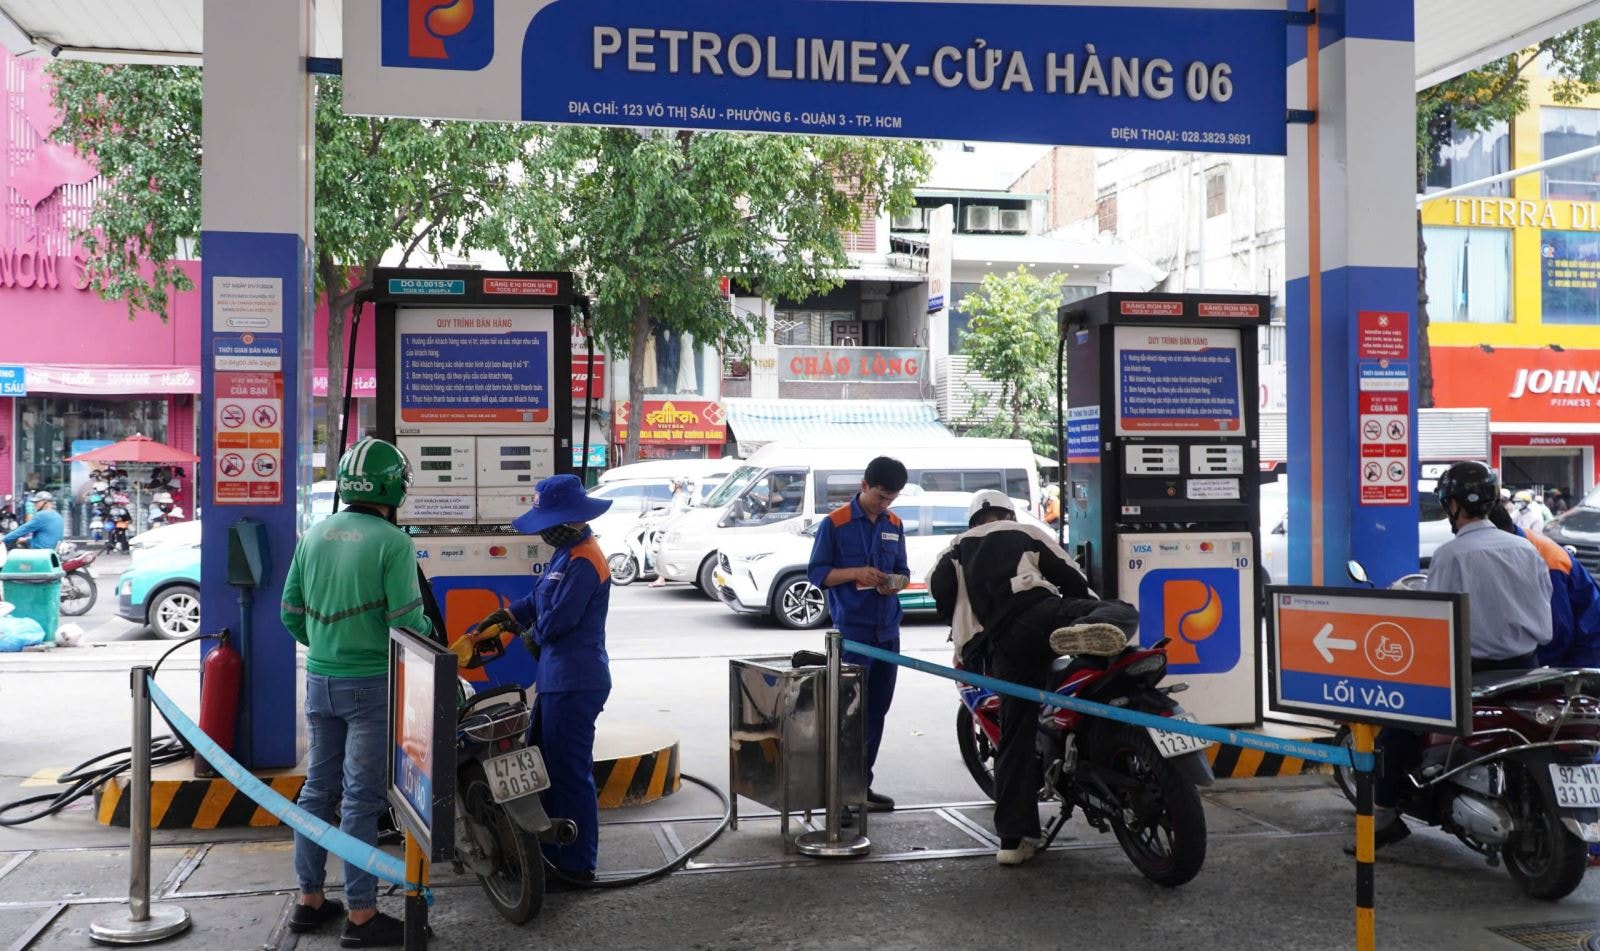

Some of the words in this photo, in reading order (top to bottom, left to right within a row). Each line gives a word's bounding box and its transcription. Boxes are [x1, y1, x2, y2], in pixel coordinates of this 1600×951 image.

[1046, 43, 1174, 100] HÀNG
[1186, 61, 1233, 103] 06
[568, 101, 591, 115] ĐỊA
[593, 100, 619, 115] CHỈ:
[622, 104, 643, 116] 123
[646, 102, 665, 117] VÕ
[667, 106, 688, 121] THỊ
[690, 104, 716, 120] SÁU
[726, 107, 781, 123] PHƯỜNG
[784, 112, 791, 123] 6
[801, 111, 836, 127] QUẬN
[839, 114, 846, 126] 3
[856, 115, 873, 127] TP.
[876, 116, 902, 128] HCM
[1111, 127, 1138, 141] ĐIỆN
[1141, 129, 1179, 143] THOẠI:
[1182, 130, 1251, 145] 028.3829.9691
[1449, 197, 1557, 227] TIERRA
[1571, 203, 1600, 229] DI
[437, 319, 451, 328] QUY
[453, 317, 474, 328] TRÌNH
[790, 352, 851, 375] CHÁO
[860, 352, 918, 376] LÒNG
[4, 380, 24, 393] SÁU
[230, 384, 248, 395] CỦA
[1508, 368, 1600, 399] JOHN
[1551, 398, 1591, 407] FITNESS
[1530, 437, 1567, 445] JOHNSON
[340, 478, 374, 492] Grab
[323, 527, 363, 542] Grab
[416, 550, 429, 558] SA
[1129, 560, 1143, 570] 09
[1235, 558, 1248, 567] 10
[1323, 679, 1354, 703] LỐI
[1360, 685, 1404, 709] VÀO
[499, 771, 540, 798] 3059
